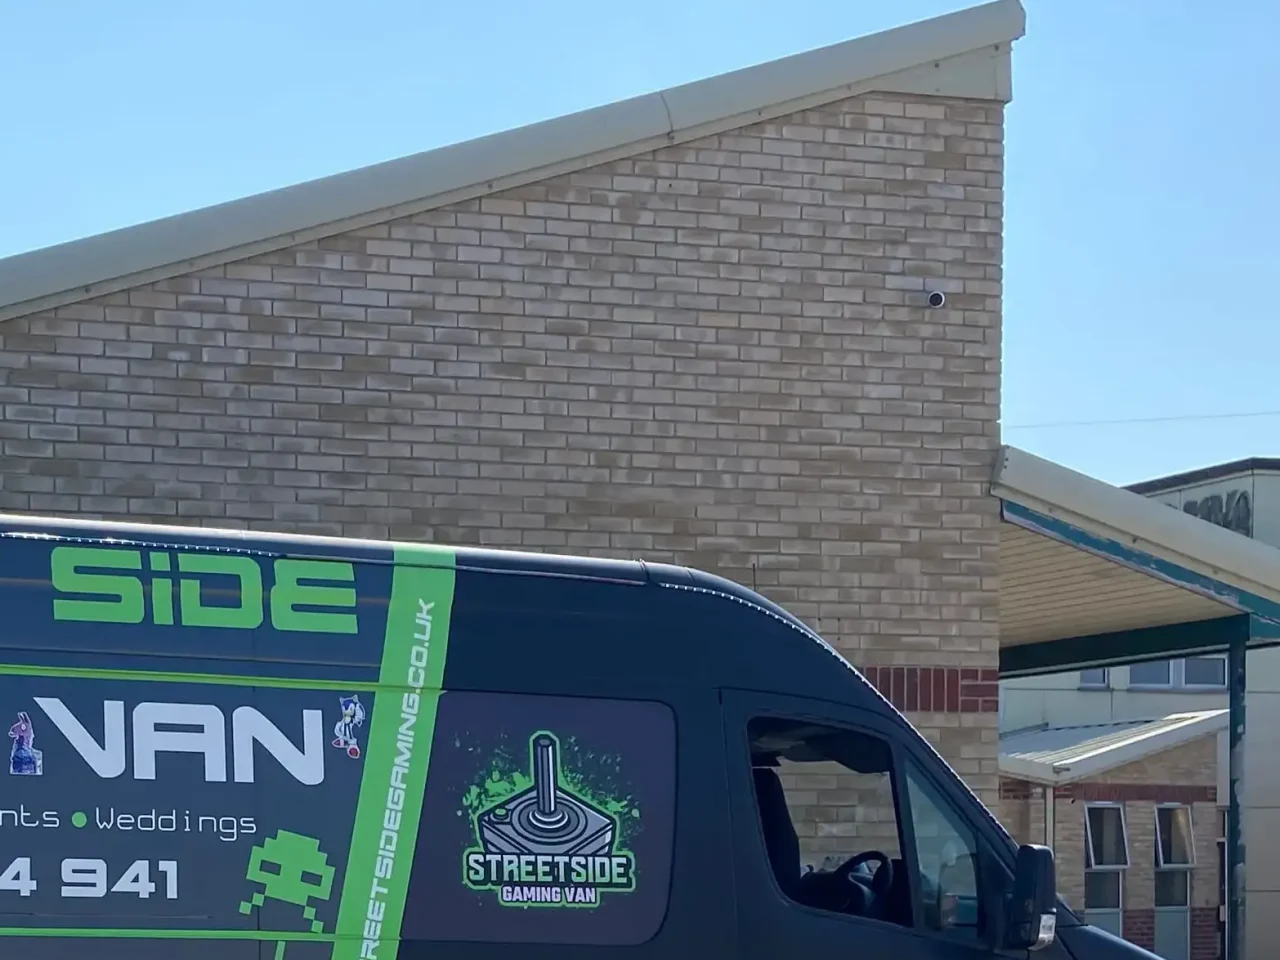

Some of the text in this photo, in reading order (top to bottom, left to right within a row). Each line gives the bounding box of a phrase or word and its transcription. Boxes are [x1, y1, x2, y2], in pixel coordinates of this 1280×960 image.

[33, 696, 325, 786] VAN
[95, 807, 257, 842] Weddings
[60, 857, 179, 899] 941
[468, 853, 628, 884] STREETSIDE
[502, 885, 596, 903] GAMING VAN
